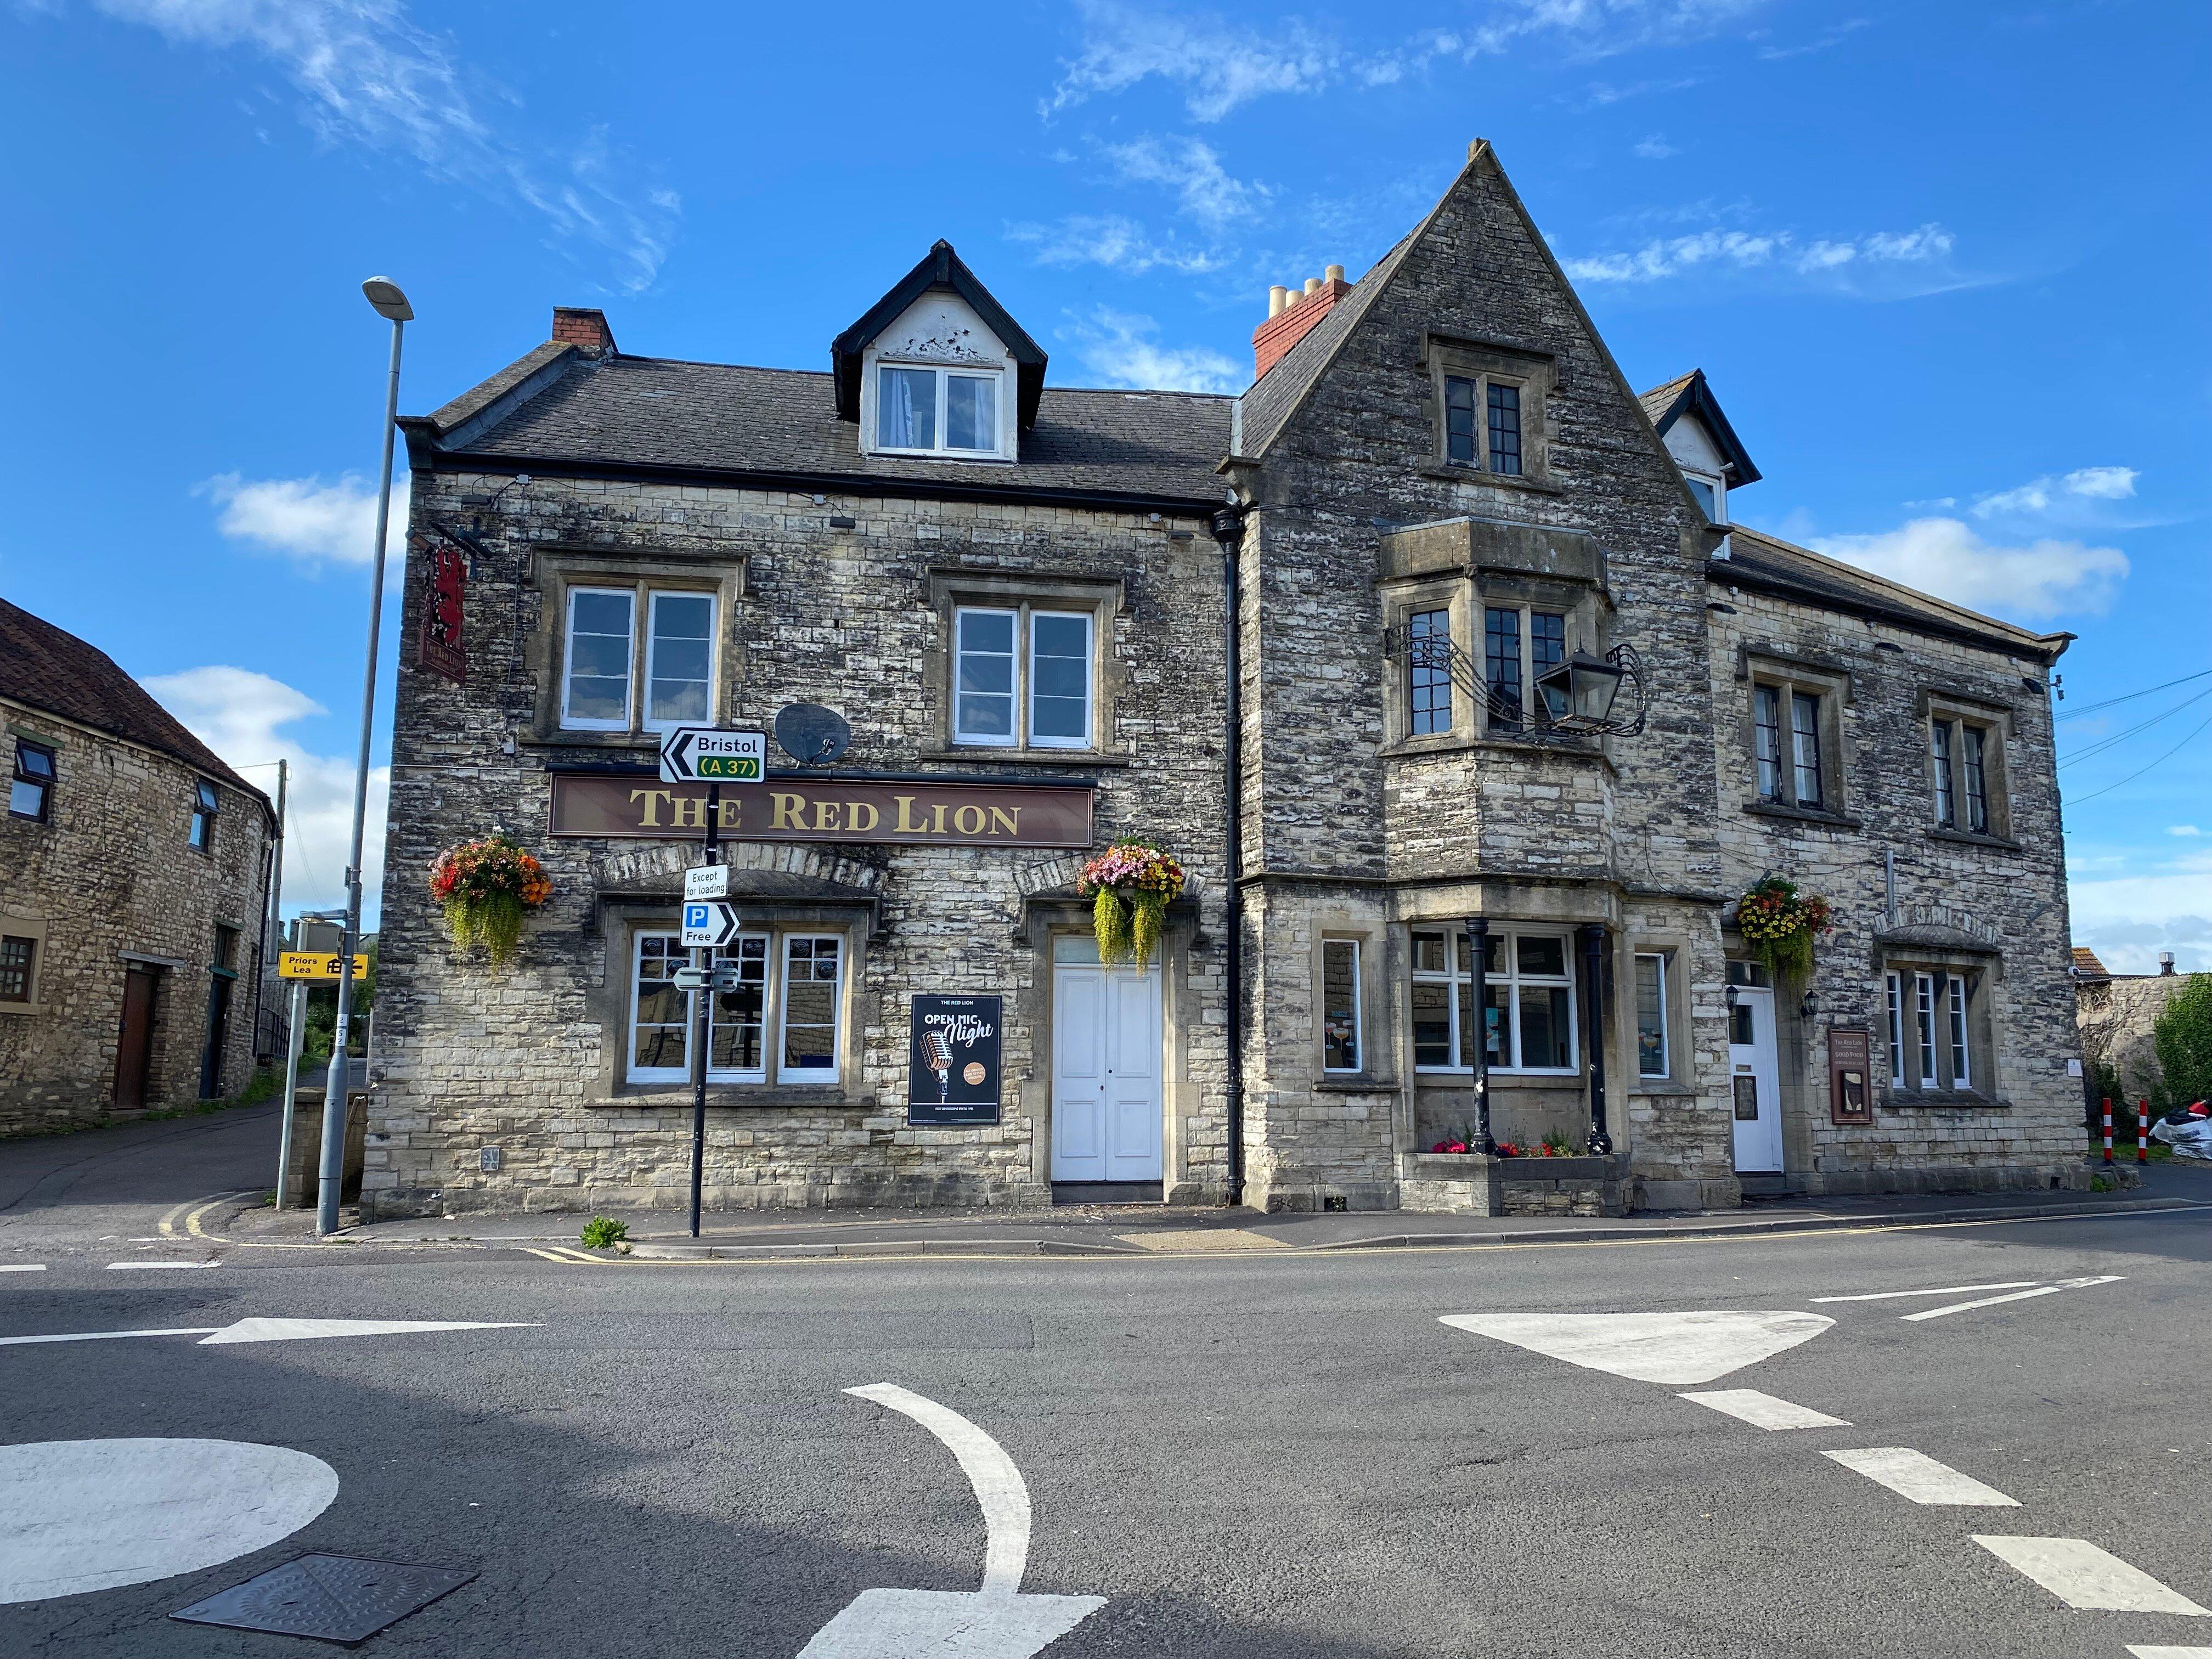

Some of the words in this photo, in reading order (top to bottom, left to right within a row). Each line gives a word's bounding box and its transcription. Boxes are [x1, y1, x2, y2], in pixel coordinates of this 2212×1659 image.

[698, 737, 758, 753] Bristol
[629, 789, 741, 828] THE
[768, 793, 879, 831] RED
[893, 795, 1022, 836] LION
[693, 871, 717, 883] Except
[686, 887, 697, 896] for
[698, 884, 725, 895] loading
[691, 908, 705, 926] P
[686, 932, 711, 941] Free
[289, 956, 318, 964] Priors
[924, 1014, 955, 1024] OPEN
[958, 1014, 978, 1024] MIC
[944, 1019, 994, 1048] Night
